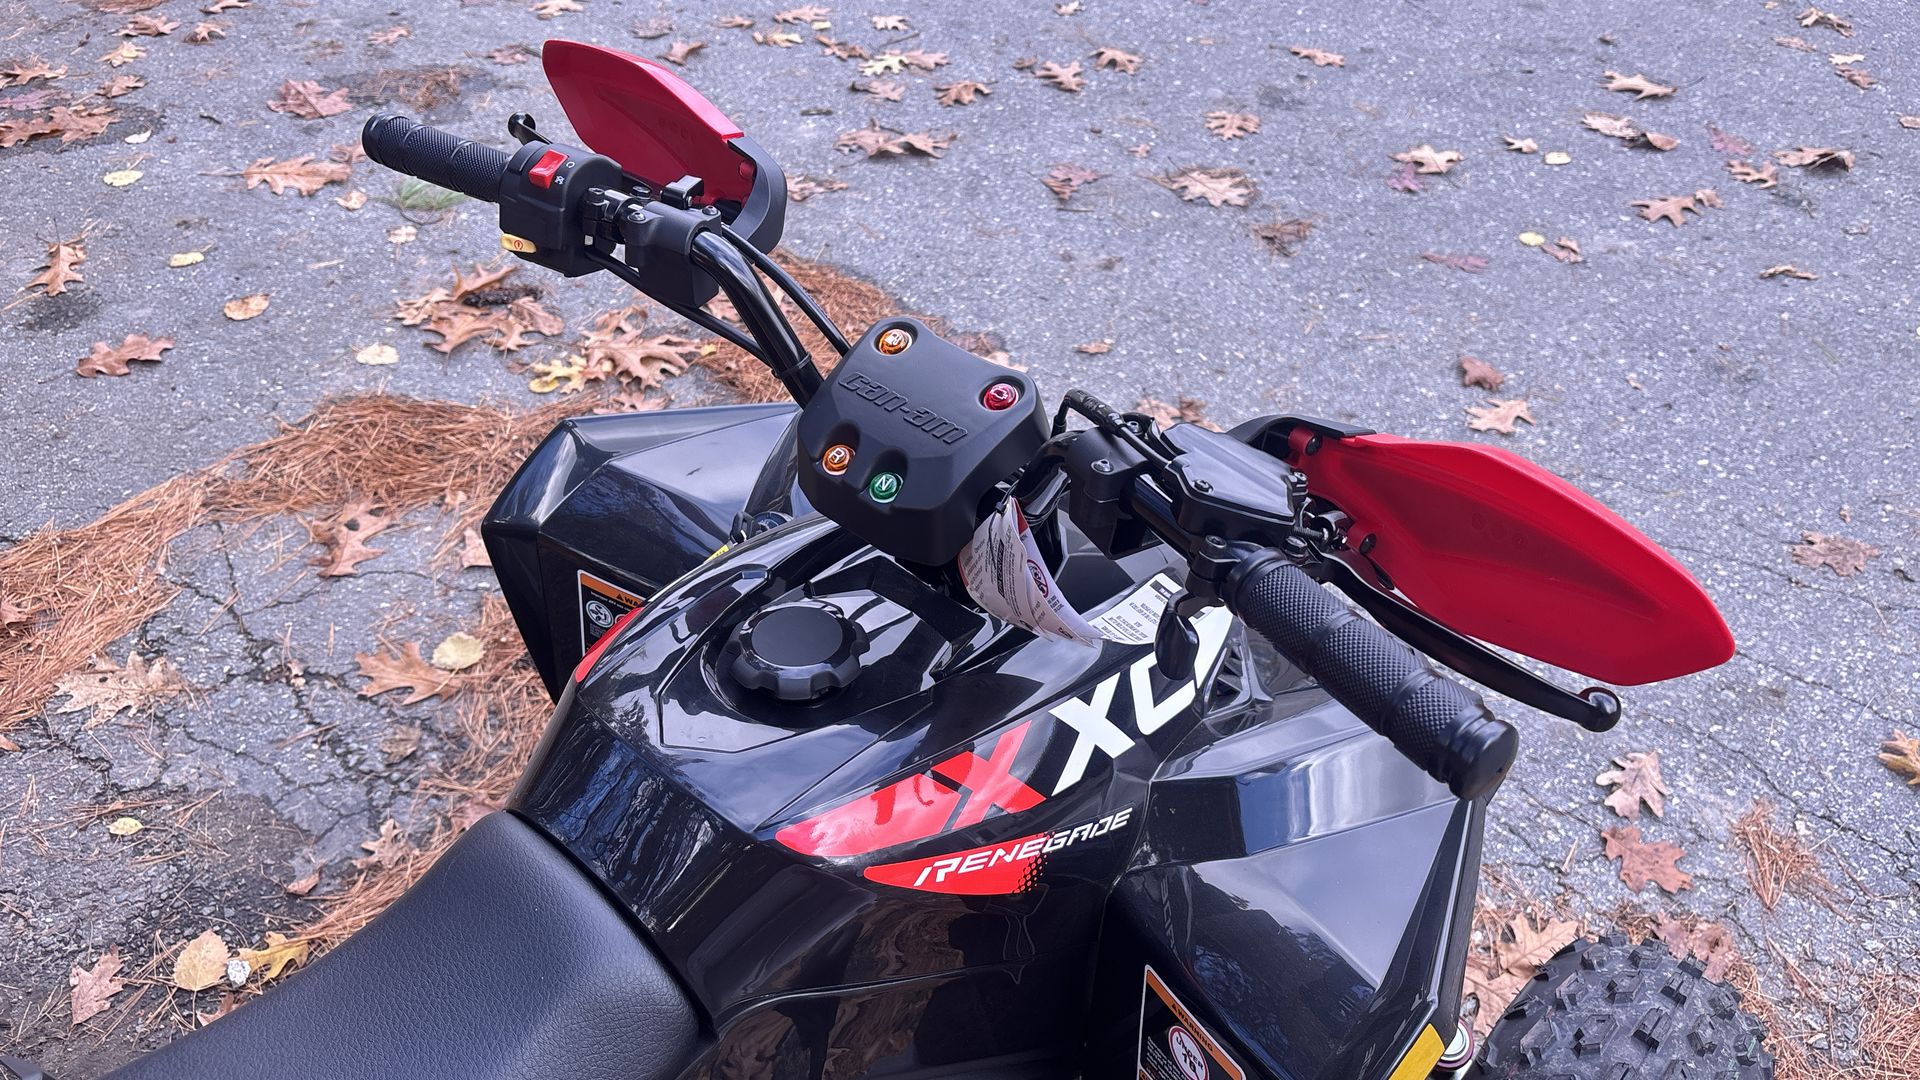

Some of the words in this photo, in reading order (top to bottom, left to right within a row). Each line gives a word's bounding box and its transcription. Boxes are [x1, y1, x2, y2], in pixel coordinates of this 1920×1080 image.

[838, 371, 969, 445] can-am
[828, 447, 845, 464] R
[875, 474, 893, 491] N
[913, 807, 1133, 887] RENEGADE
[1177, 1009, 1213, 1052] WARNING
[1175, 1035, 1204, 1071] UNDER
